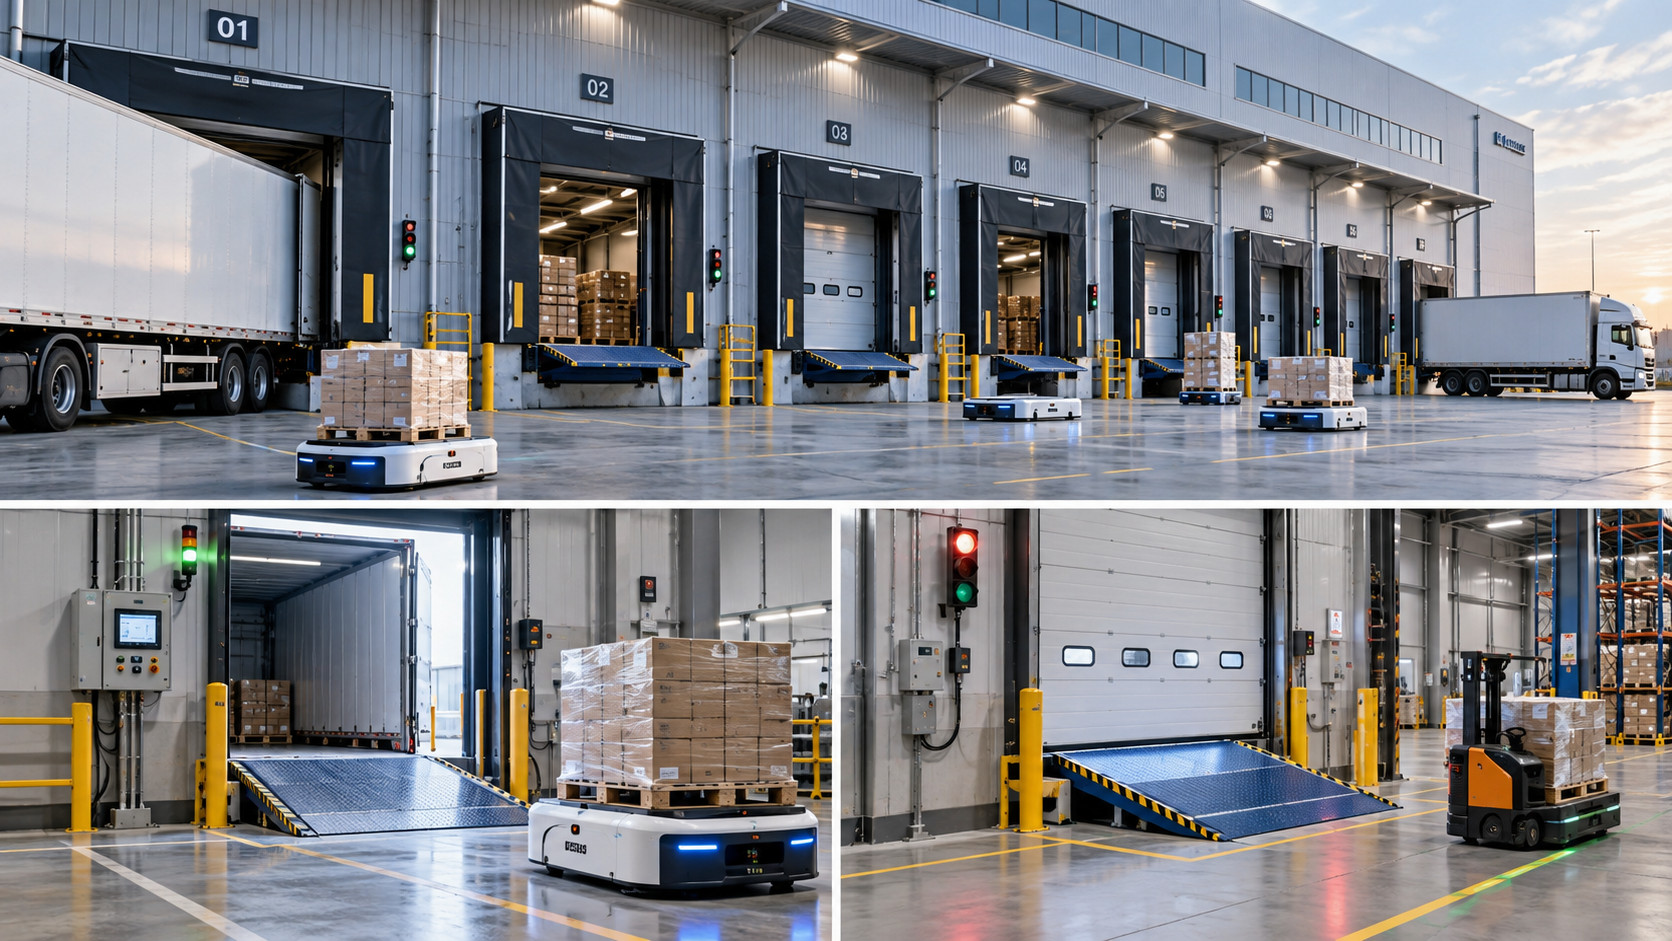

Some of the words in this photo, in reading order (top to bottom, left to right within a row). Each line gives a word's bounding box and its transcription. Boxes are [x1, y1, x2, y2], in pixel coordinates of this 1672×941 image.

[217, 16, 247, 41] 01
[587, 78, 608, 98] 02
[831, 124, 848, 141] 03
[1014, 159, 1027, 174] 04
